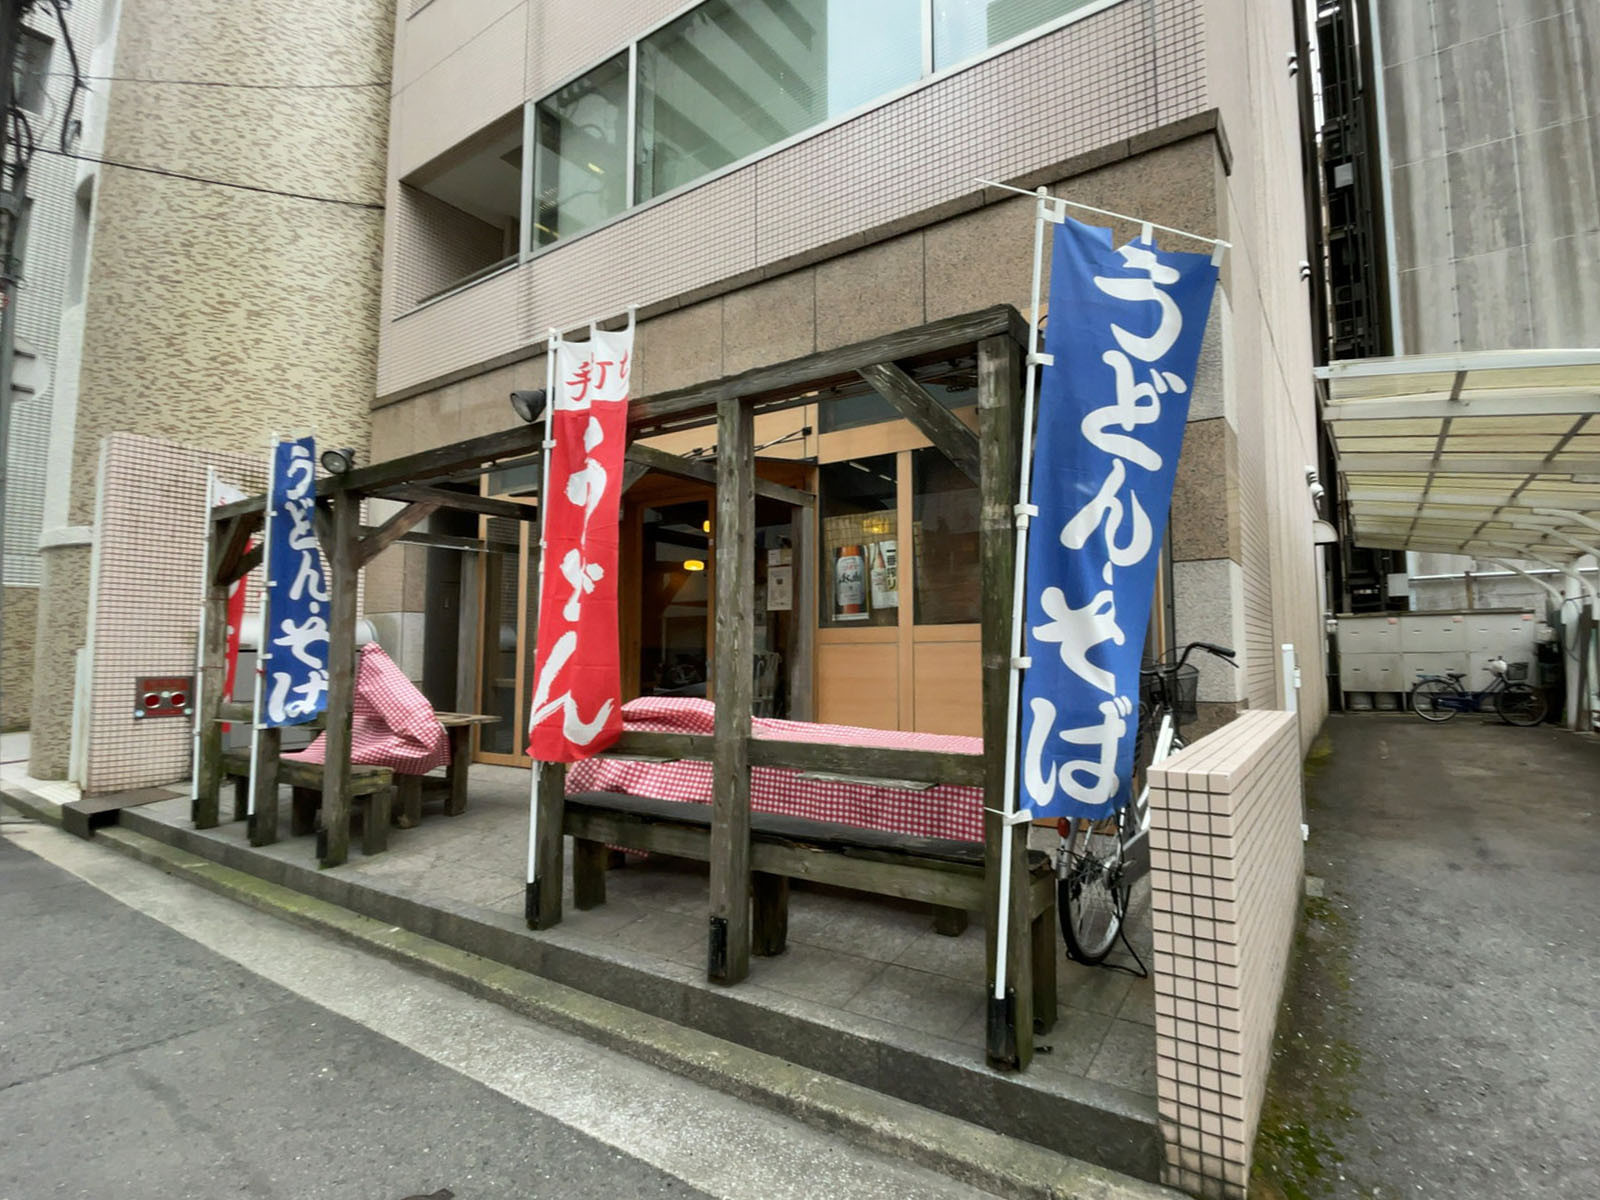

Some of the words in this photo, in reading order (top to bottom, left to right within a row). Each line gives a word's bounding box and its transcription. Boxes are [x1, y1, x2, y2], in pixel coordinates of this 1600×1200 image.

[268, 445, 330, 723] うどん・そば
[529, 415, 615, 747] うどん
[1023, 244, 1187, 806] うどん・そば
